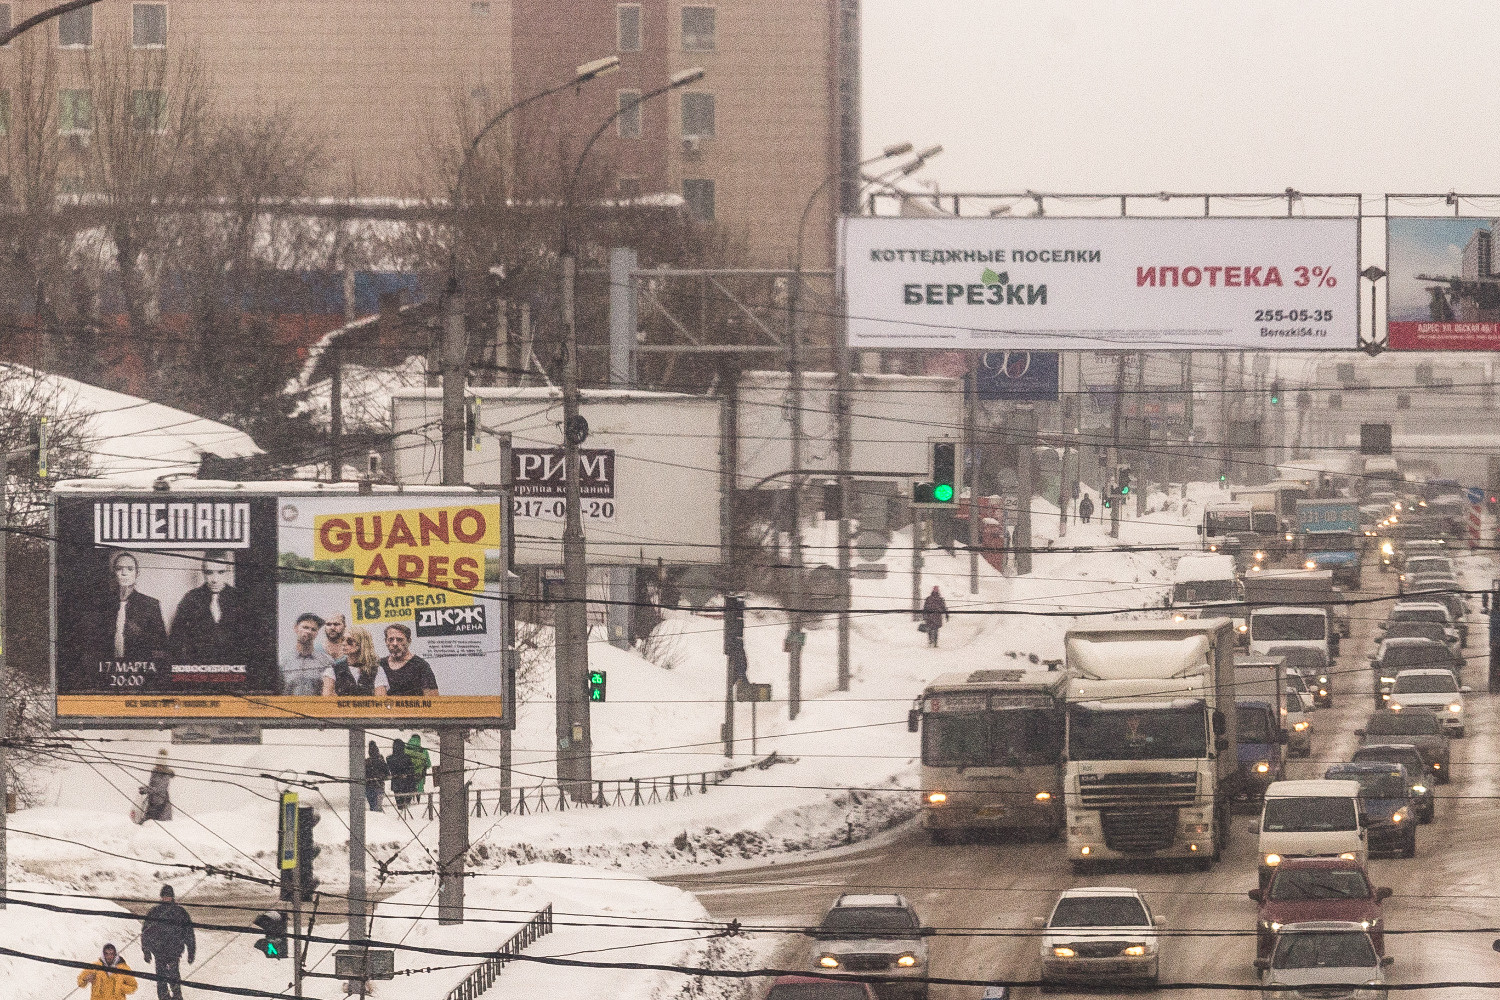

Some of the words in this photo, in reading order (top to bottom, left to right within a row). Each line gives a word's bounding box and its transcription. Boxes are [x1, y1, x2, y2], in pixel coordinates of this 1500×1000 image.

[870, 249, 1006, 264] КОТТЕДЖНЫЕ
[1012, 249, 1101, 263] ПОСЕЛКИ
[1136, 265, 1284, 288] ИПОТЕКА
[1293, 265, 1338, 288] 3%
[903, 283, 1048, 305] БЕРЕЗКИ
[1254, 309, 1334, 322] 255-05-35
[515, 453, 609, 481] РИМ
[514, 484, 552, 495] группа
[556, 484, 610, 494] коаний
[514, 500, 615, 518] 217-0-20
[94, 502, 250, 549] LINDEMANN
[319, 508, 487, 553] GUANO
[361, 552, 479, 591] APES
[353, 597, 382, 621] 18
[384, 593, 447, 608] АПРЕЛЯ
[417, 607, 484, 627] ДКЖ
[455, 623, 484, 632] АРЕНА
[98, 661, 111, 673] 17
[115, 661, 158, 673] МАРТА
[109, 675, 144, 686] 20:00
